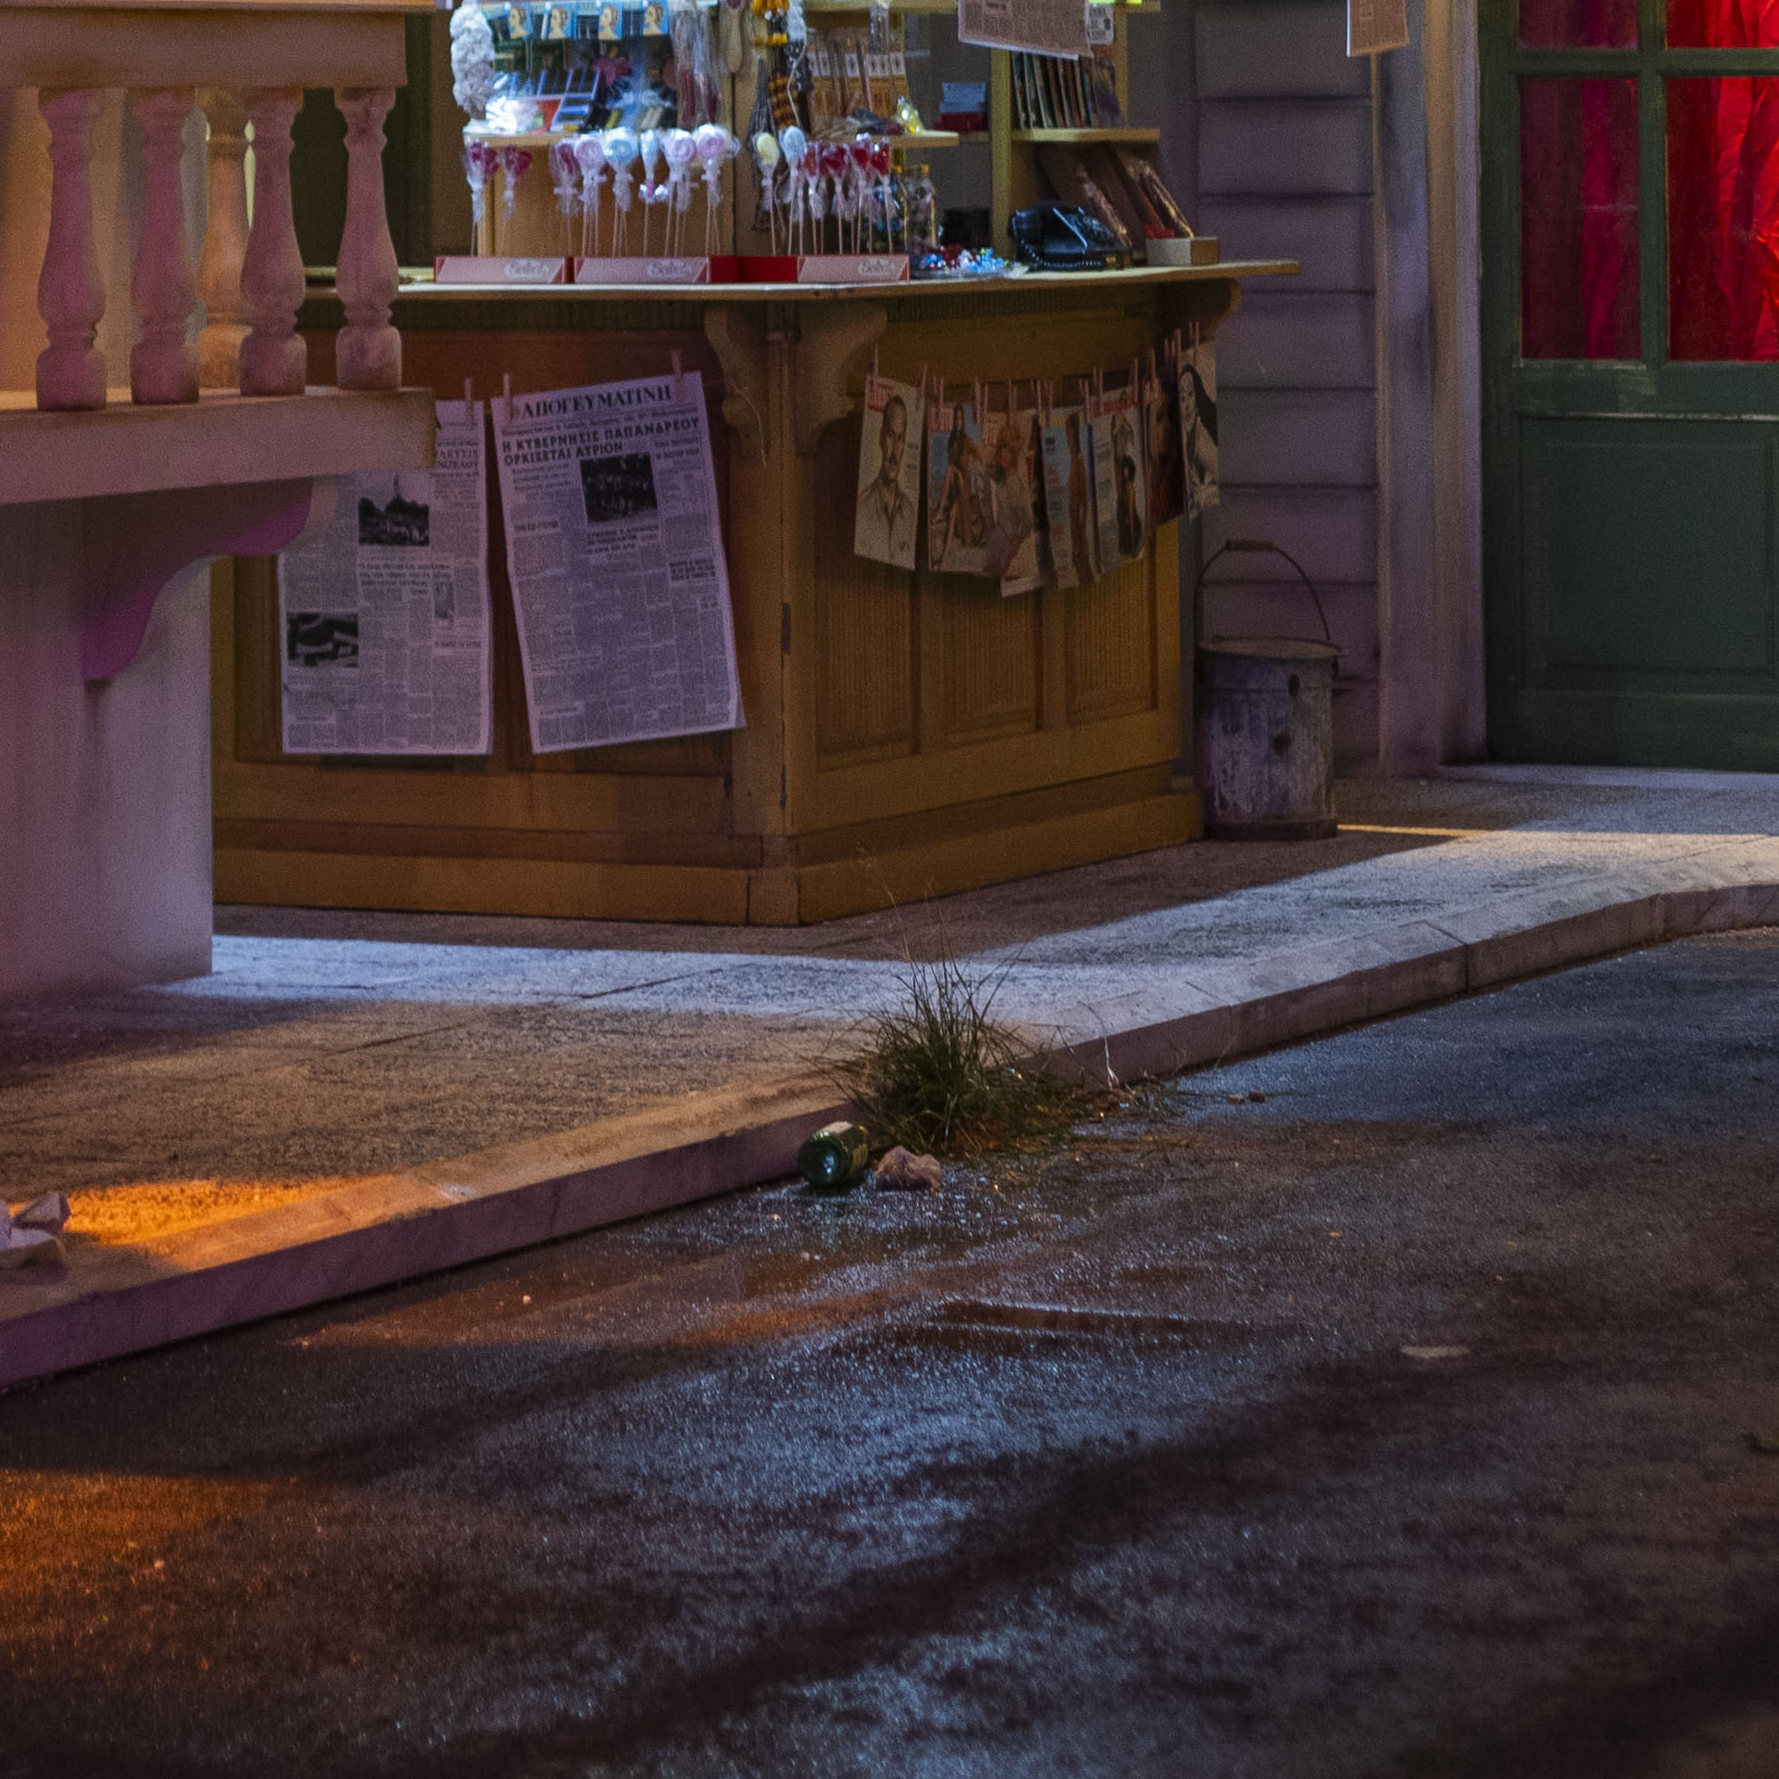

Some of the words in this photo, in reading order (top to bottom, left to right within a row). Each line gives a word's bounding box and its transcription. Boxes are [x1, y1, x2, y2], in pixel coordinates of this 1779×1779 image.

[522, 385, 672, 419] ΑΠΟΓΕΥΜΑΤΙΝΗ
[604, 417, 700, 441] ΠΑΠΑΝΔΡΕΟΥ
[575, 441, 624, 458] ΑΥΡΙΟΝ
